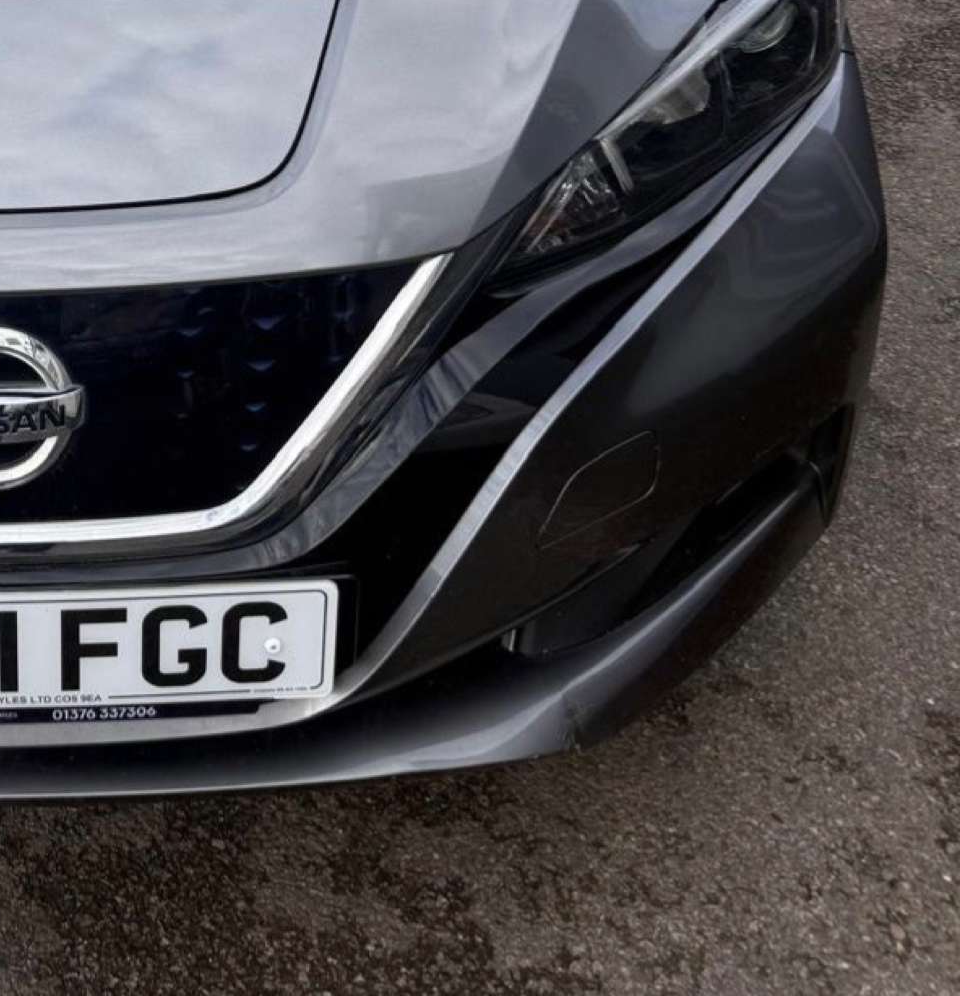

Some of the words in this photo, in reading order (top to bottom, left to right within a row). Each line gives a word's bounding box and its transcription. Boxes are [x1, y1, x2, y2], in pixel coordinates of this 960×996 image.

[60, 601, 288, 692] FGC
[30, 695, 52, 704] LTD
[52, 708, 96, 721] 01376
[99, 706, 157, 720] 337306
